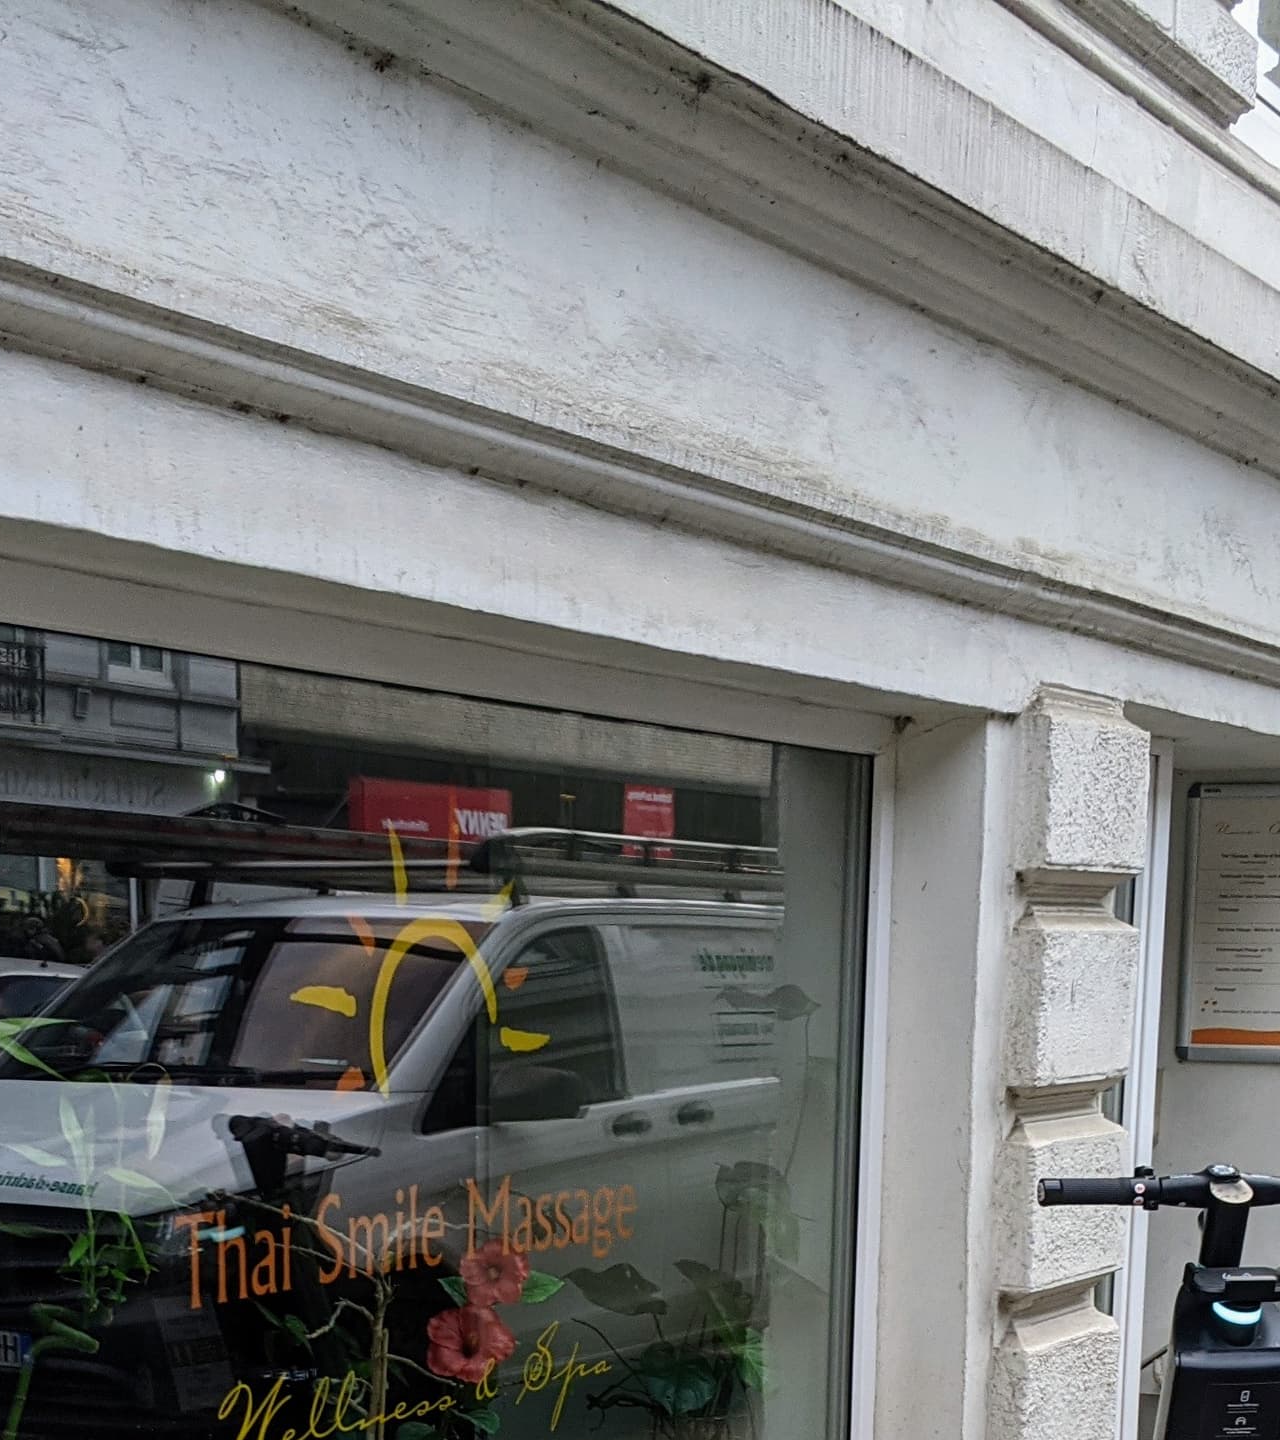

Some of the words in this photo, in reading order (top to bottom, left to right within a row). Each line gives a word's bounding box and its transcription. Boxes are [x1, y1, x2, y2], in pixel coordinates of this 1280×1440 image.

[175, 1204, 293, 1309] Thai
[317, 1184, 444, 1284] Smile
[464, 1175, 638, 1259] Massage
[516, 1321, 612, 1432] Spa
